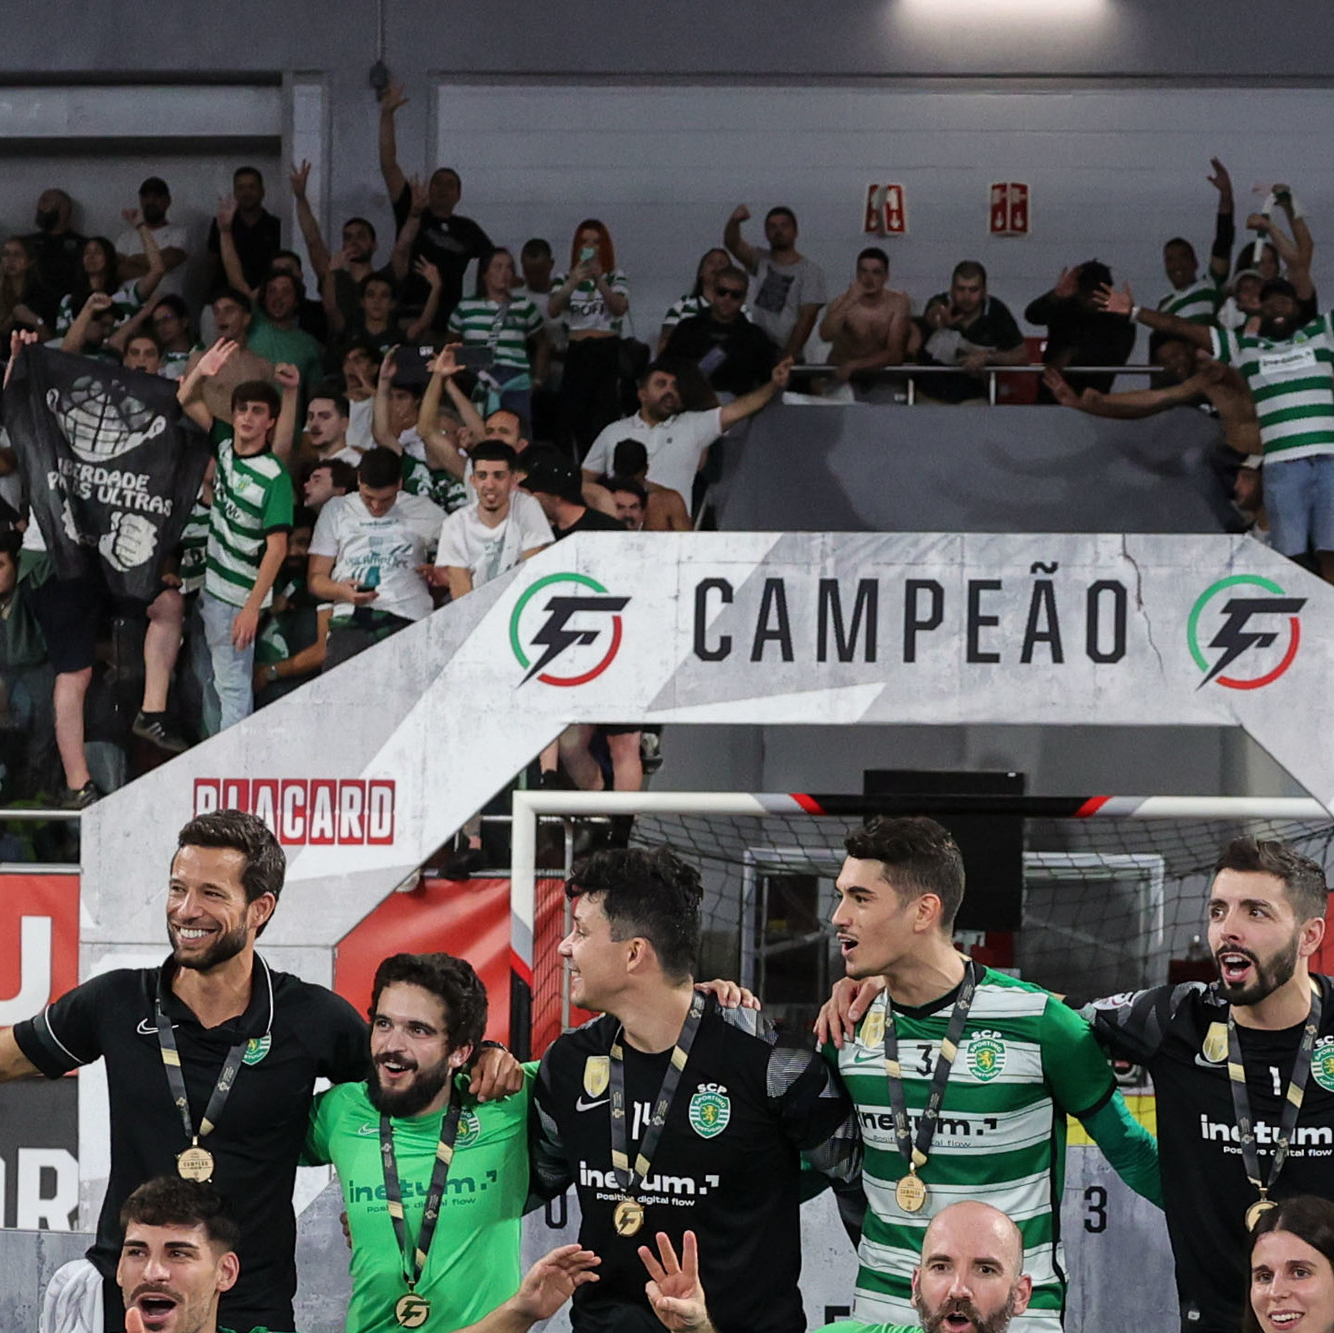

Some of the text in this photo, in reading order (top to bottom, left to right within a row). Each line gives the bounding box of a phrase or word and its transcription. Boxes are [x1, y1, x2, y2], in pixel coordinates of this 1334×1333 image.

[97, 486, 174, 517] ULTRAS
[693, 561, 1127, 663] CAMPEÃO
[971, 1029, 1003, 1040] SCP
[969, 1039, 1003, 1054] SPORTING
[916, 1044, 933, 1077] 3
[970, 1068, 1000, 1080] PORTUGAL
[1269, 1066, 1282, 1096] 1
[697, 1083, 727, 1094] SCP
[694, 1095, 726, 1109] SPORTING
[1308, 1148, 1333, 1157] flow
[579, 1160, 719, 1195] ineum.
[637, 1195, 669, 1205] digital
[671, 1198, 695, 1207] flow
